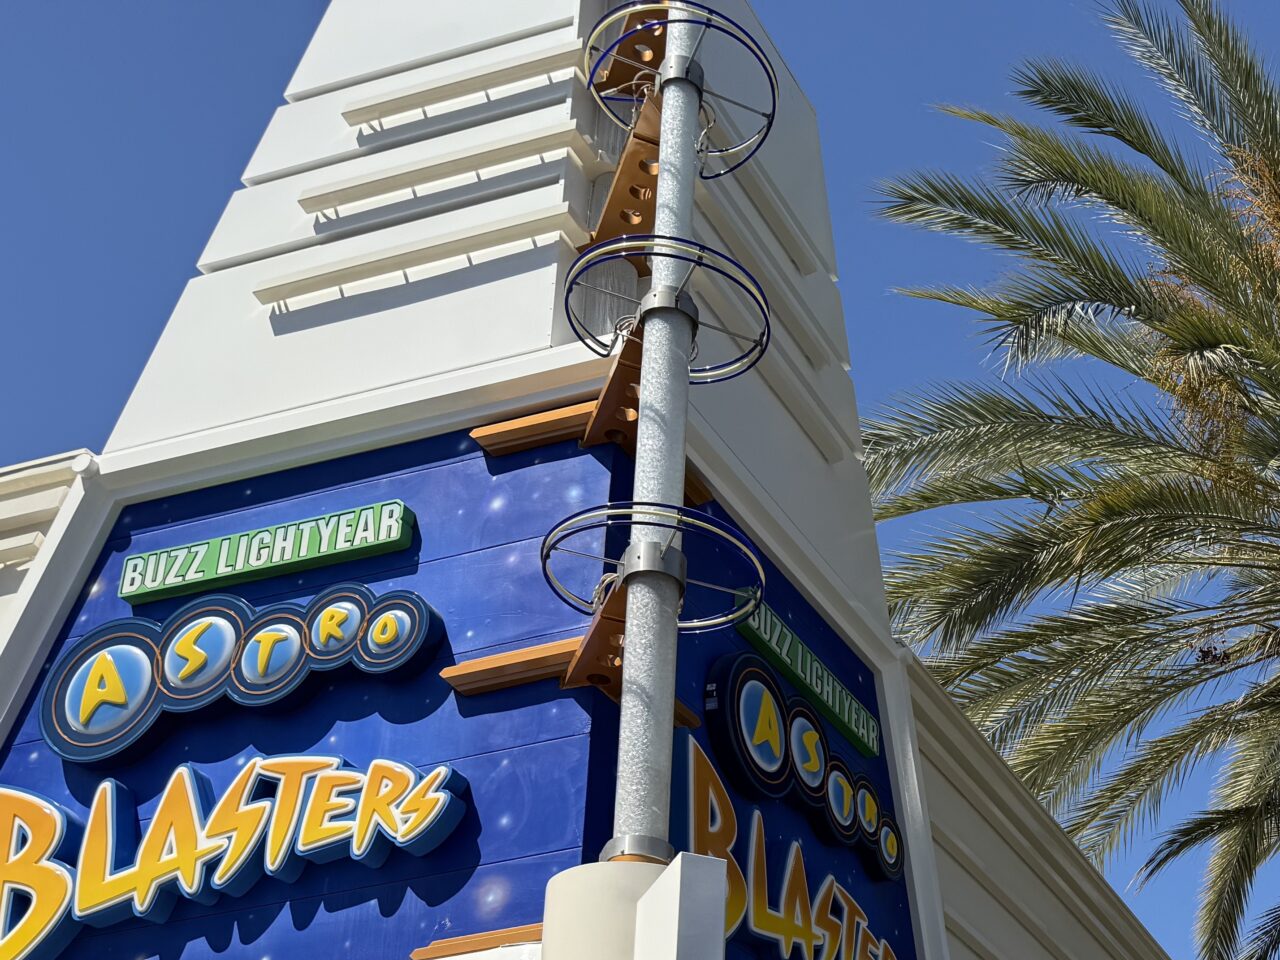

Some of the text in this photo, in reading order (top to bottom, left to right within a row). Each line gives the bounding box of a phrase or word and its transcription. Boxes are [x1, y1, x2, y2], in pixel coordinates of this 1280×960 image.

[121, 501, 403, 596] BUZZ LIGHTYEAR
[78, 606, 406, 726] ASTRO
[747, 600, 879, 755] BUZZ LIGHTYEAR
[751, 688, 899, 861] ASTRO
